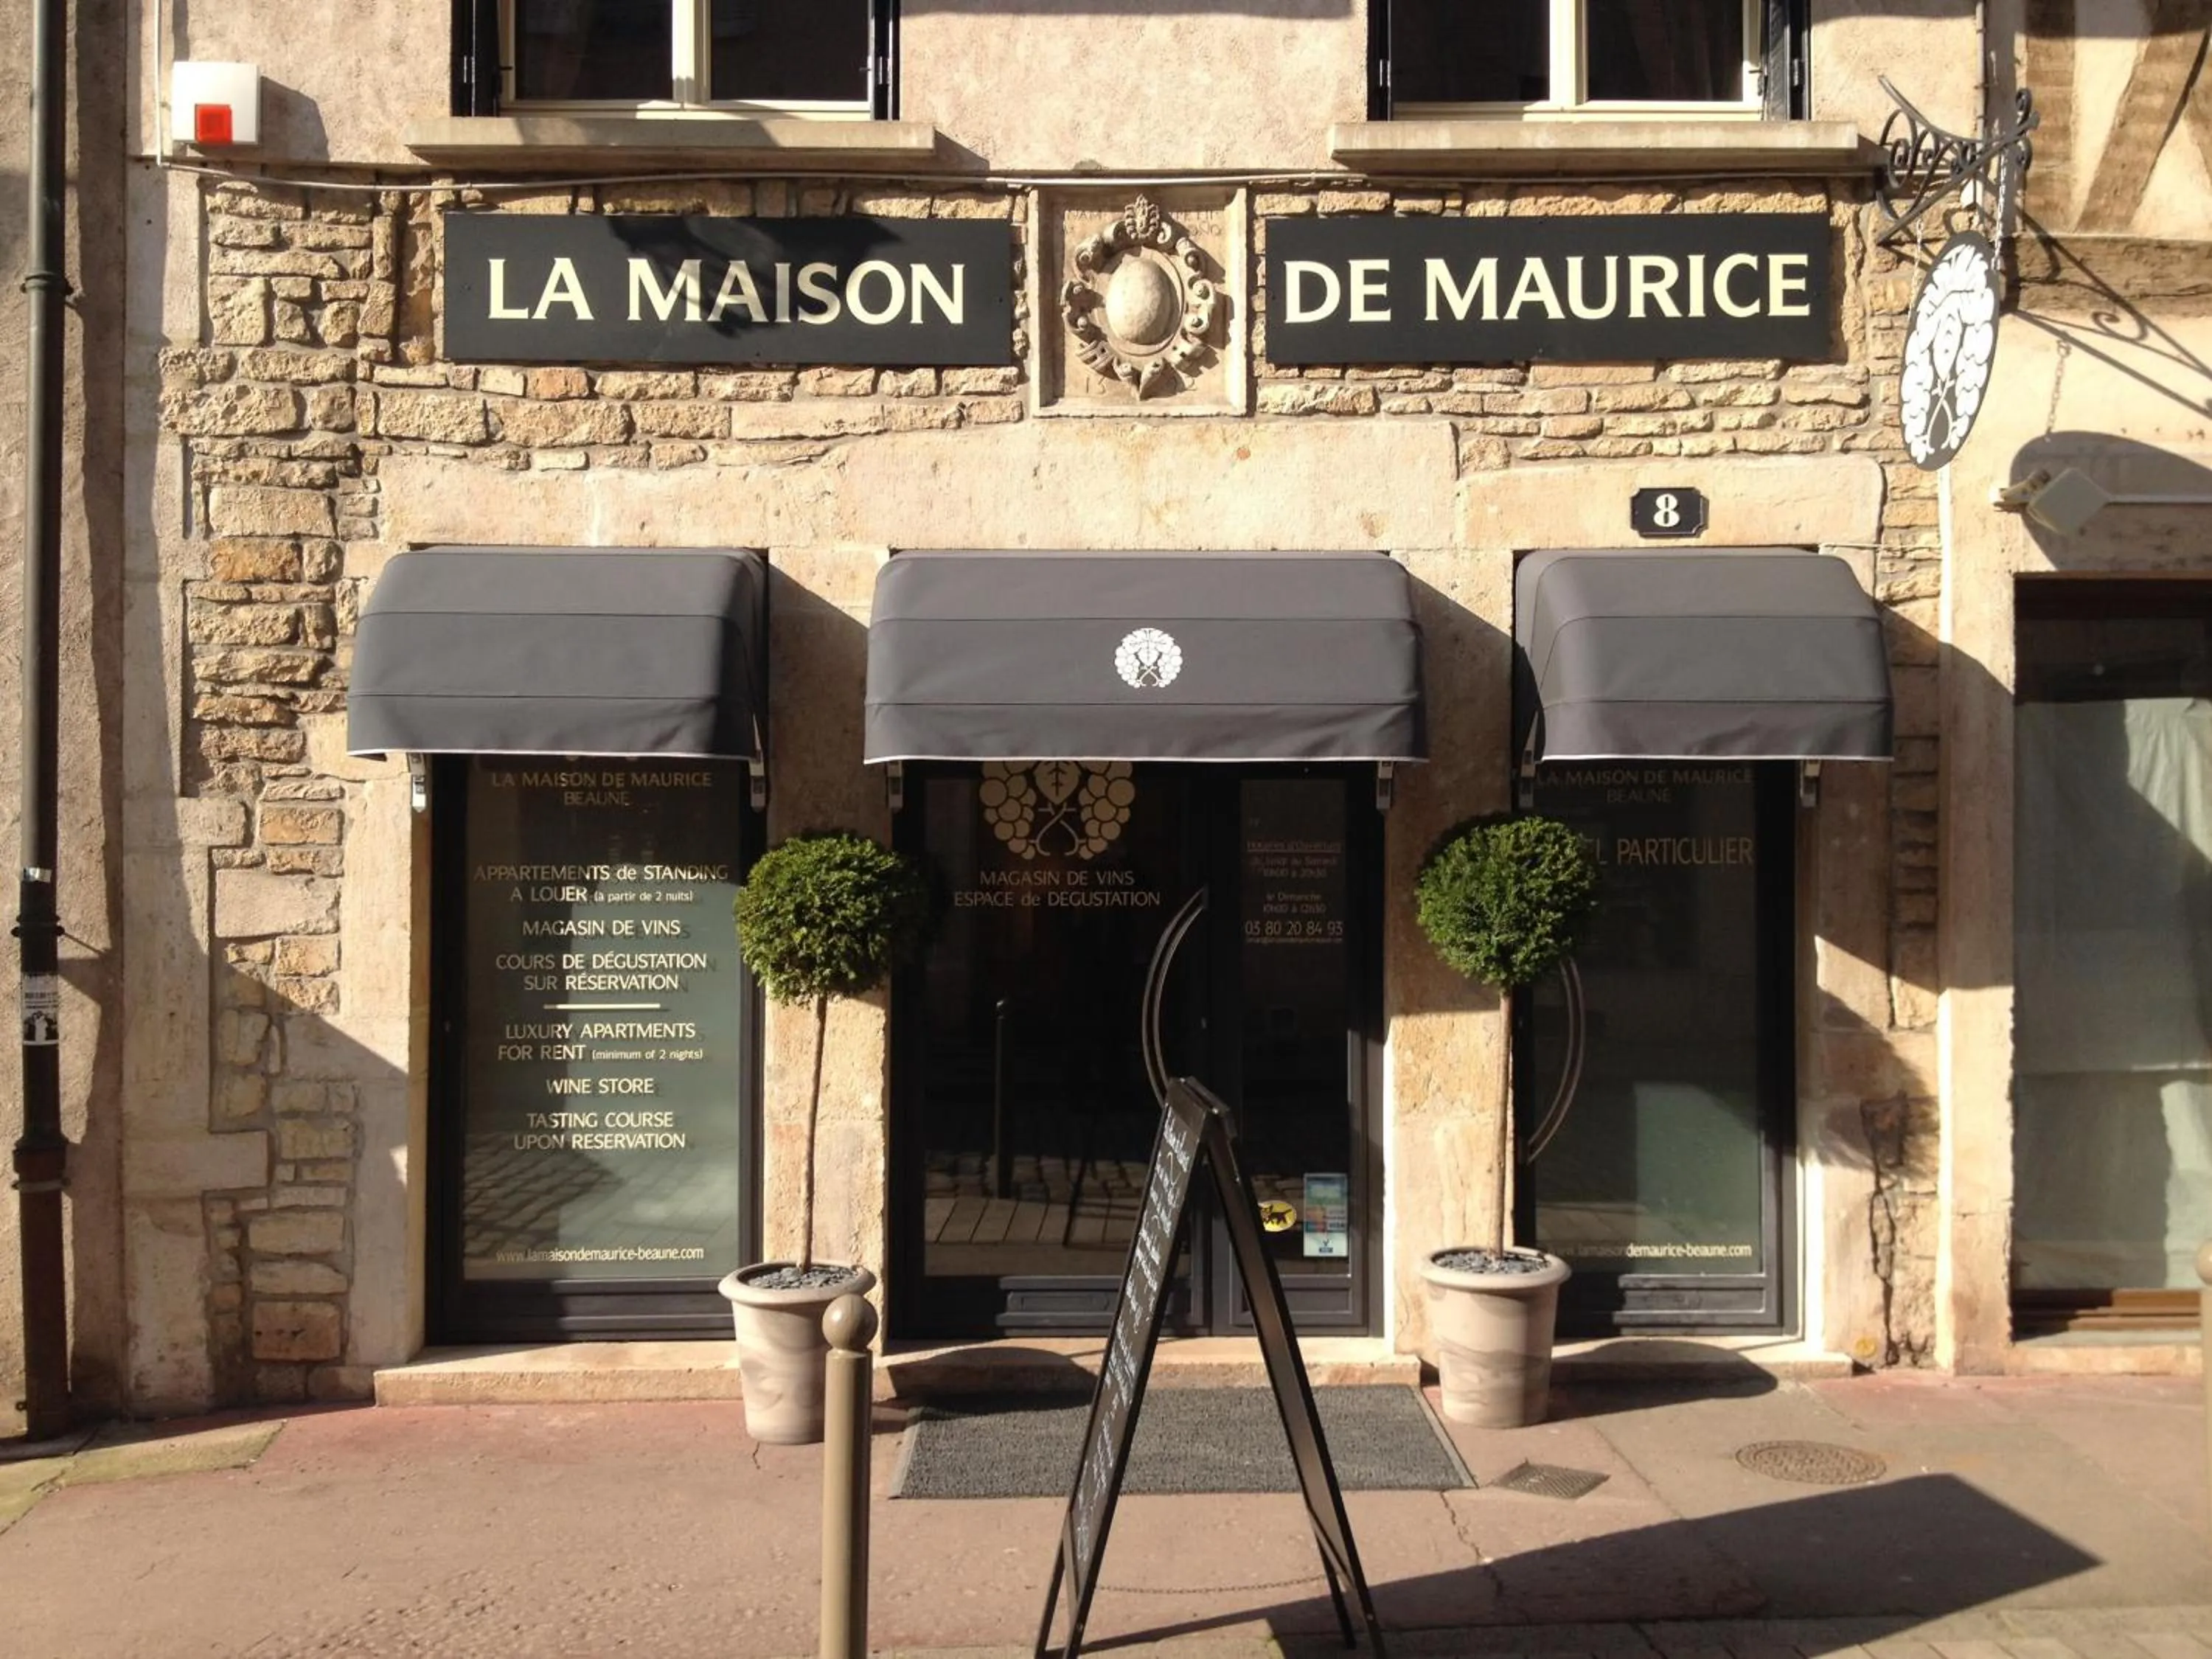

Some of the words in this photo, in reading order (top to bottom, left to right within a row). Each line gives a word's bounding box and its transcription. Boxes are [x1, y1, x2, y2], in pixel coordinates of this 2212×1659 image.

[488, 258, 594, 320] LA
[627, 259, 964, 324] MAISON
[1284, 259, 1392, 323] DE
[1425, 253, 1811, 321] MAURICE
[1654, 493, 1680, 527] 8
[492, 773, 515, 787] LA
[522, 772, 596, 787] MAISON
[602, 772, 625, 787] DE
[631, 772, 712, 787] MAURICE
[1537, 771, 1558, 787] LA
[1565, 770, 1639, 785] MAISON
[1644, 770, 1669, 785] DE
[1673, 768, 1753, 785] MAURICE
[564, 791, 630, 806] BEAUNE
[1607, 789, 1672, 804] BEAUNE
[1617, 838, 1754, 866] PARTICULIER
[474, 865, 610, 880] APPARTEMENTS
[616, 865, 636, 880] de
[644, 865, 728, 880] STANDING
[980, 871, 1060, 886] MAGASIN
[1066, 870, 1088, 886] DE
[1096, 870, 1135, 886] VINS
[531, 886, 588, 902] LOUER
[608, 891, 635, 902] partir
[639, 891, 653, 902] de
[655, 891, 662, 901] 2
[665, 890, 693, 902] nuits)
[954, 891, 1015, 906] ESPACE
[1020, 891, 1041, 906] de
[1048, 891, 1161, 906] DEGUSTATION
[523, 920, 605, 936] MAGASIN
[613, 920, 633, 935] DE
[642, 920, 681, 935] VINS
[1265, 920, 1281, 936] 80
[1286, 920, 1302, 936] 20
[1306, 920, 1323, 936] 84
[496, 954, 554, 970] COURS
[563, 954, 585, 970] DE
[592, 951, 706, 969] DÉGUSTATION
[524, 975, 557, 990] SUR
[565, 973, 678, 990] RÉSERVATION
[506, 1024, 572, 1039] LUXURY
[580, 1023, 695, 1038] APARTMENTS
[498, 1045, 532, 1061] FOR
[540, 1045, 586, 1060] RENT
[592, 1048, 641, 1060] (minimum
[644, 1048, 655, 1060] of
[659, 1049, 666, 1060] 2
[669, 1048, 703, 1061] nights)
[546, 1079, 591, 1094] WINE
[598, 1078, 654, 1093] STORE
[526, 1113, 598, 1128] TASTING
[605, 1112, 673, 1127] COURSE
[514, 1134, 564, 1150] UPON
[571, 1133, 685, 1150] RESERVATION
[495, 1247, 704, 1262] www.lamaisondemaurice-beaune.com
